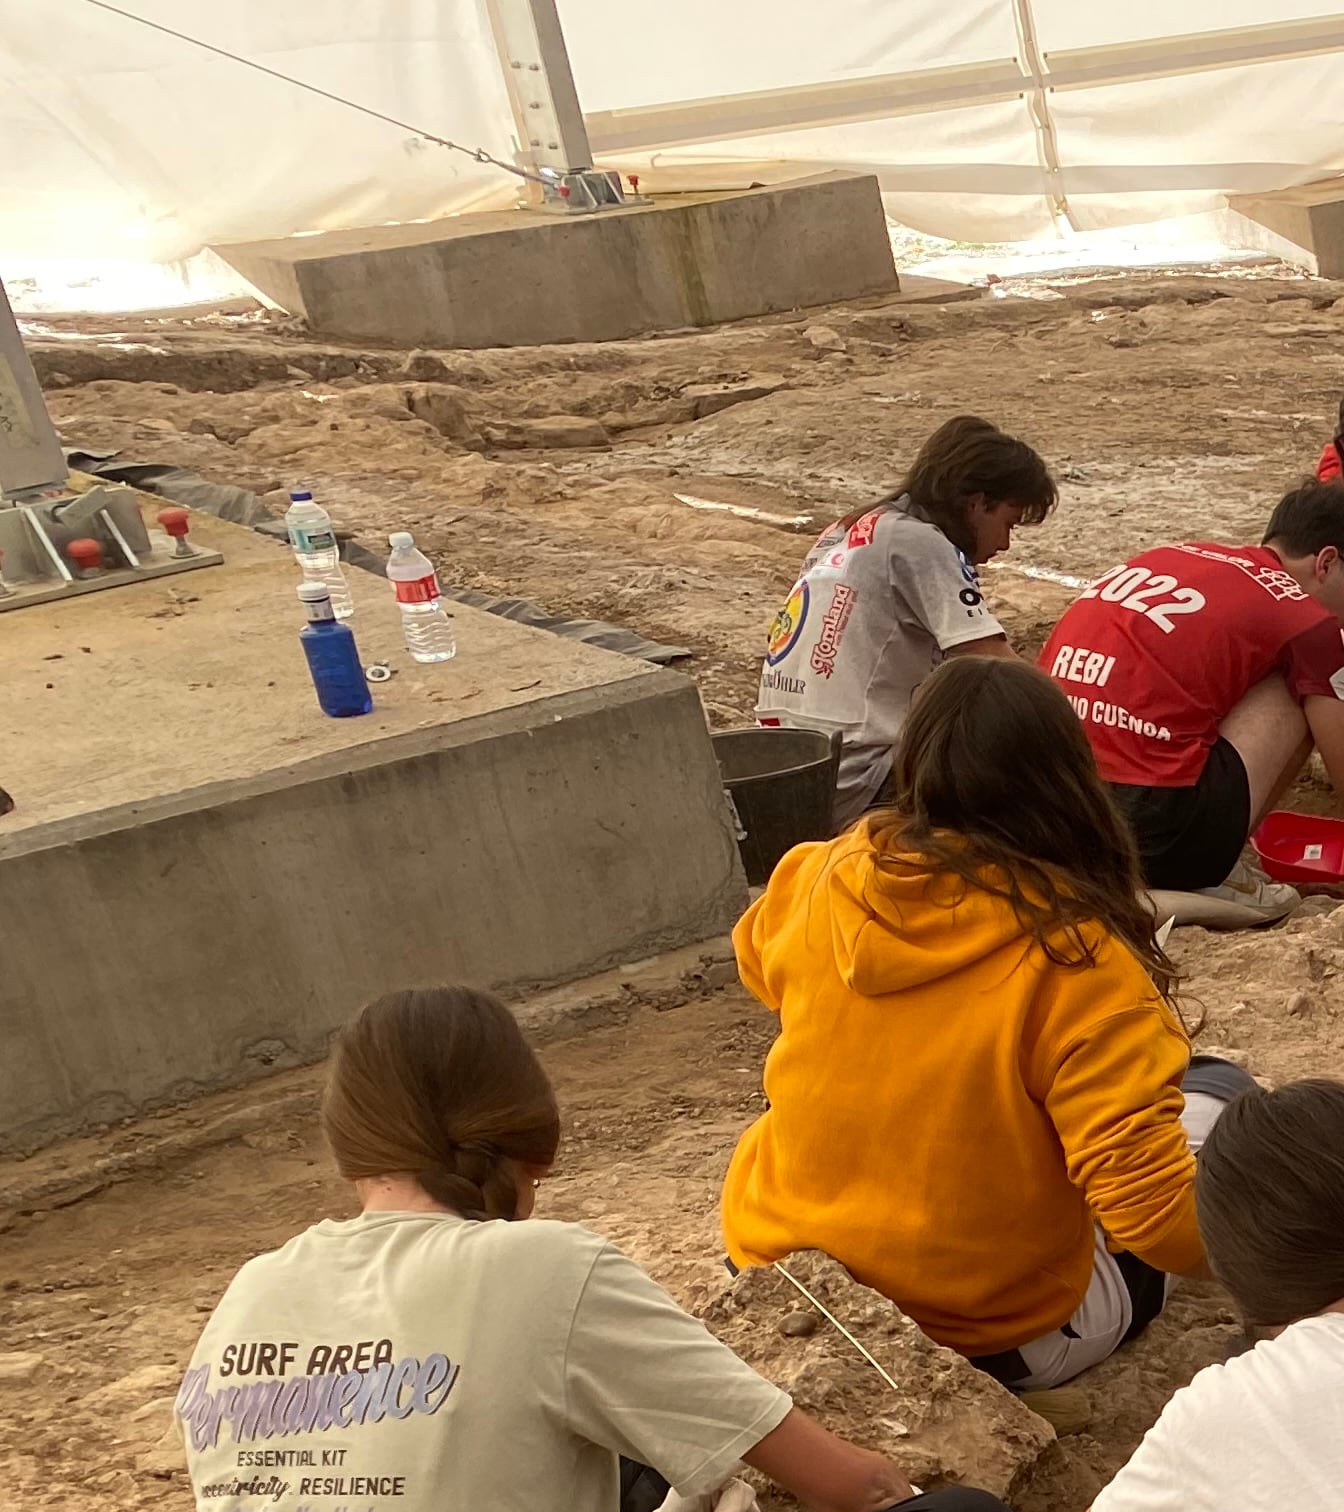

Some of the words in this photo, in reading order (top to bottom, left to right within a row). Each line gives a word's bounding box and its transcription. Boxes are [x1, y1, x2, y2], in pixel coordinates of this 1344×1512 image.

[1078, 564, 1206, 634] 2022
[1051, 645, 1116, 687] REBI
[219, 1342, 299, 1377] SURF
[306, 1339, 393, 1375] AREA
[237, 1450, 317, 1467] ESSENTIAL
[322, 1449, 348, 1466] KIT
[300, 1476, 406, 1496] RESILIENCE
